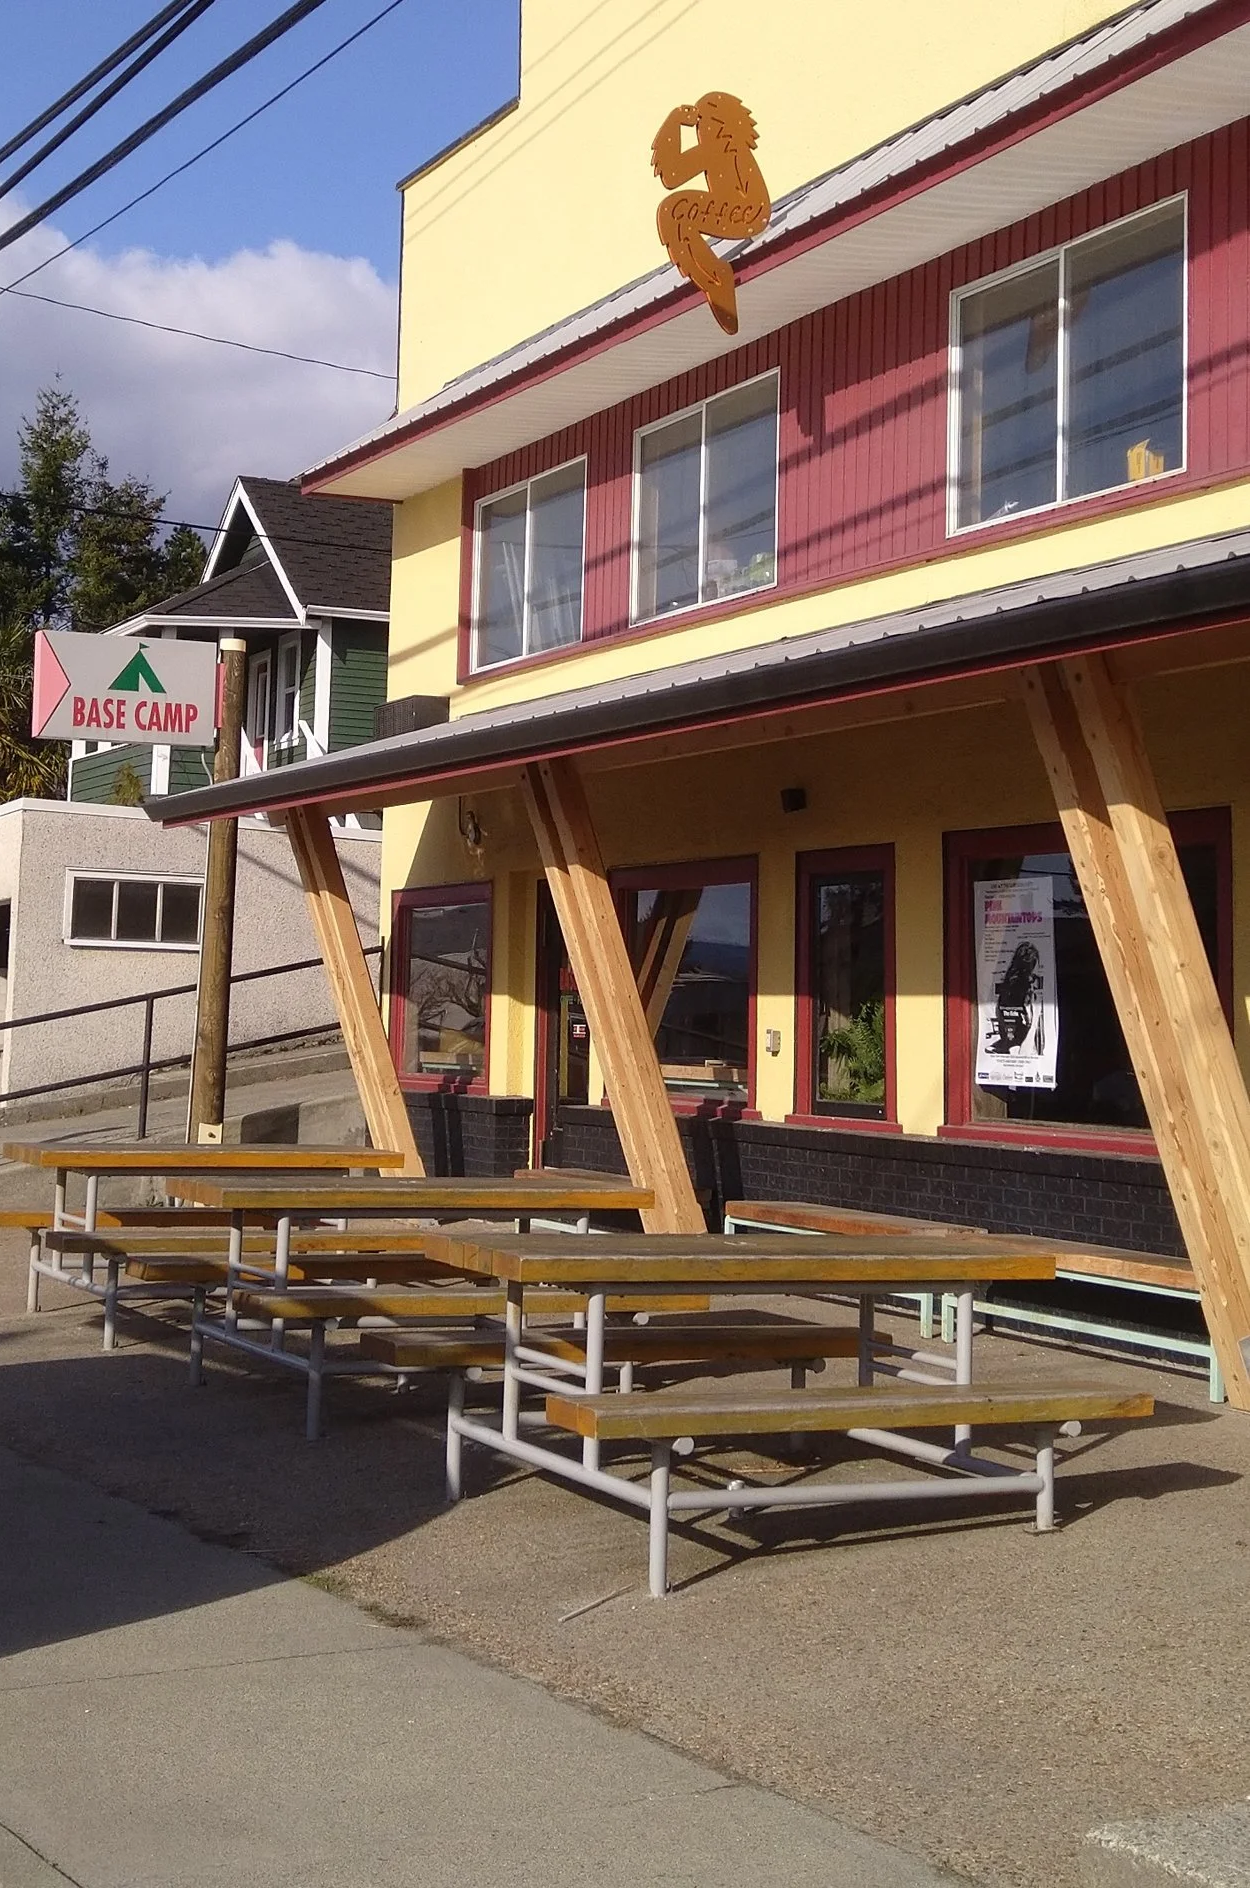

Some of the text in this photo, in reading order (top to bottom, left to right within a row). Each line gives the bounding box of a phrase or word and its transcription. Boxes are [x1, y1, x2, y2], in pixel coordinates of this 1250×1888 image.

[671, 198, 763, 224] Coffee
[72, 696, 199, 733] BASE CAMP
